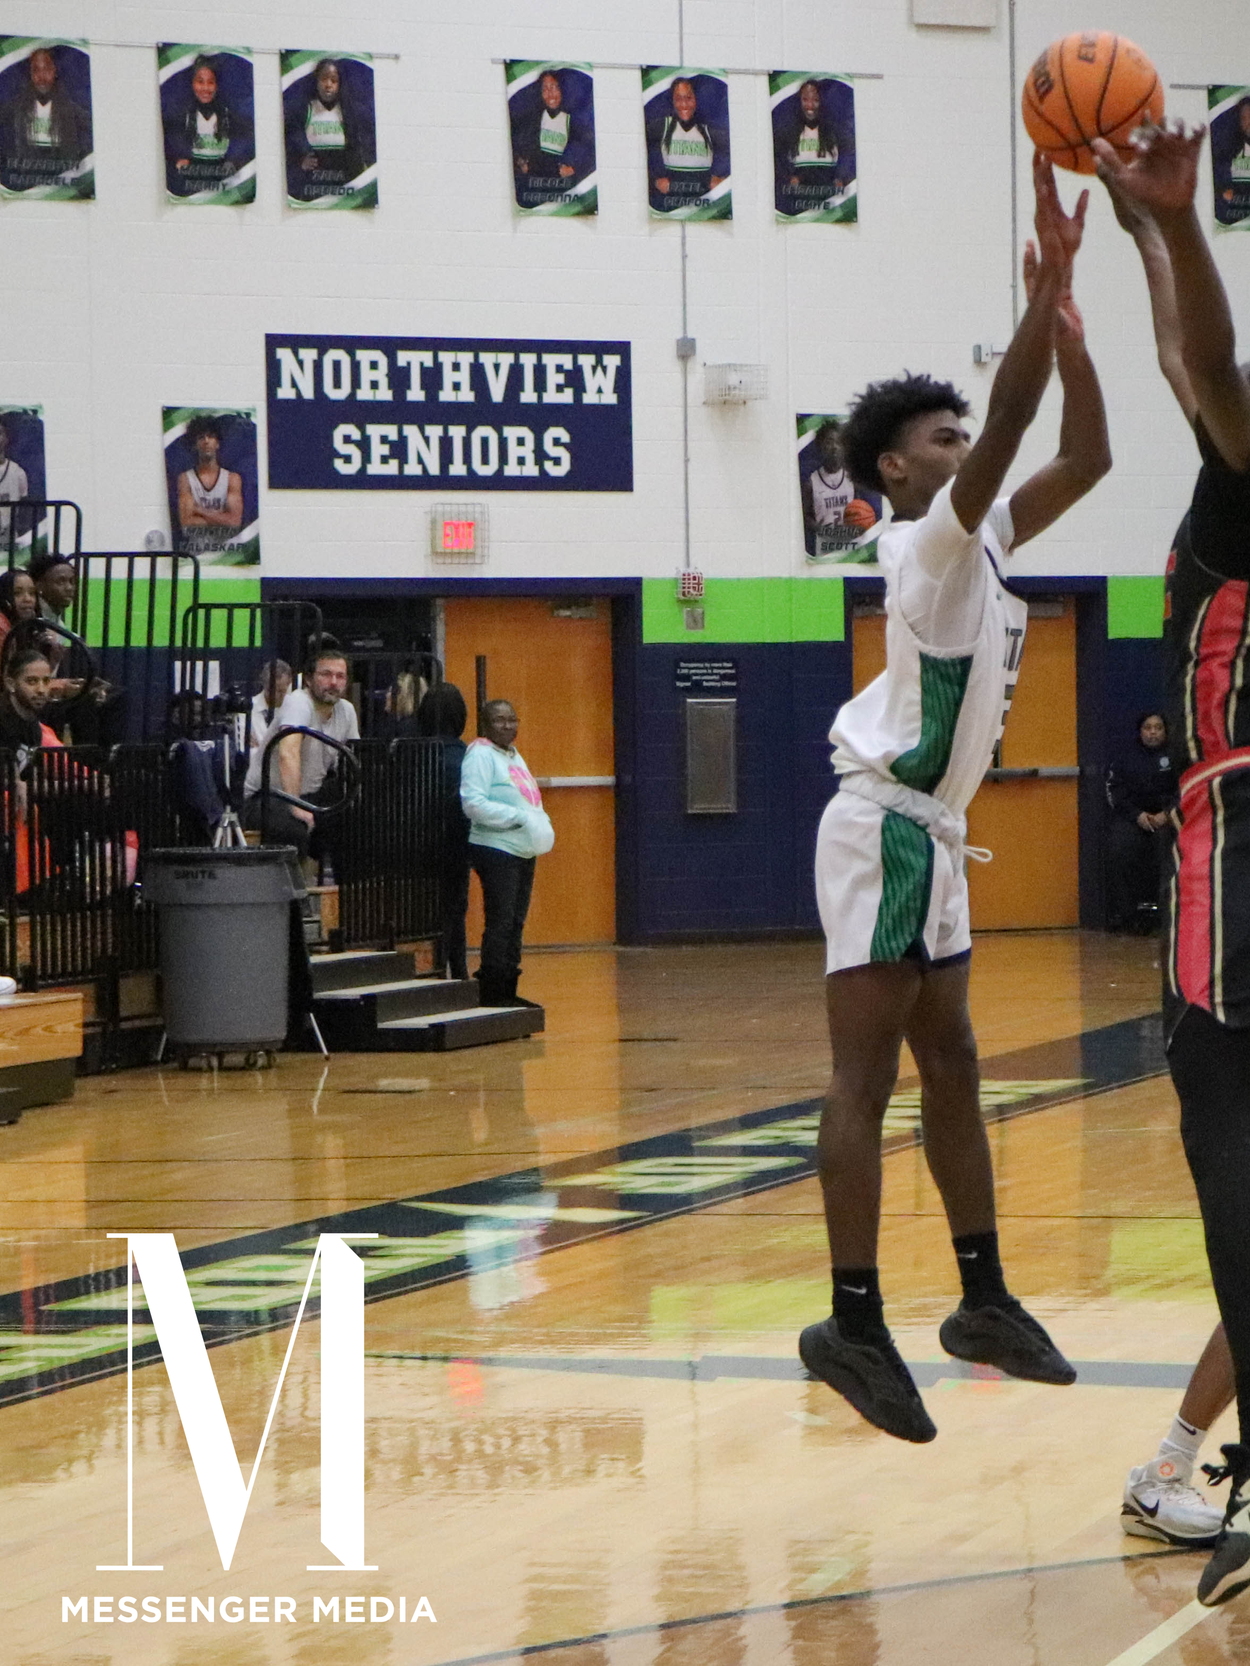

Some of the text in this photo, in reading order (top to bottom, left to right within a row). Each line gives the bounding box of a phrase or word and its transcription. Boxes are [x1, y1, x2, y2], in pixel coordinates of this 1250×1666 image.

[275, 347, 621, 405] NORTHVIEW
[333, 423, 571, 477] SENIORS
[442, 520, 475, 549] EXIT
[820, 541, 858, 551] SCOTT
